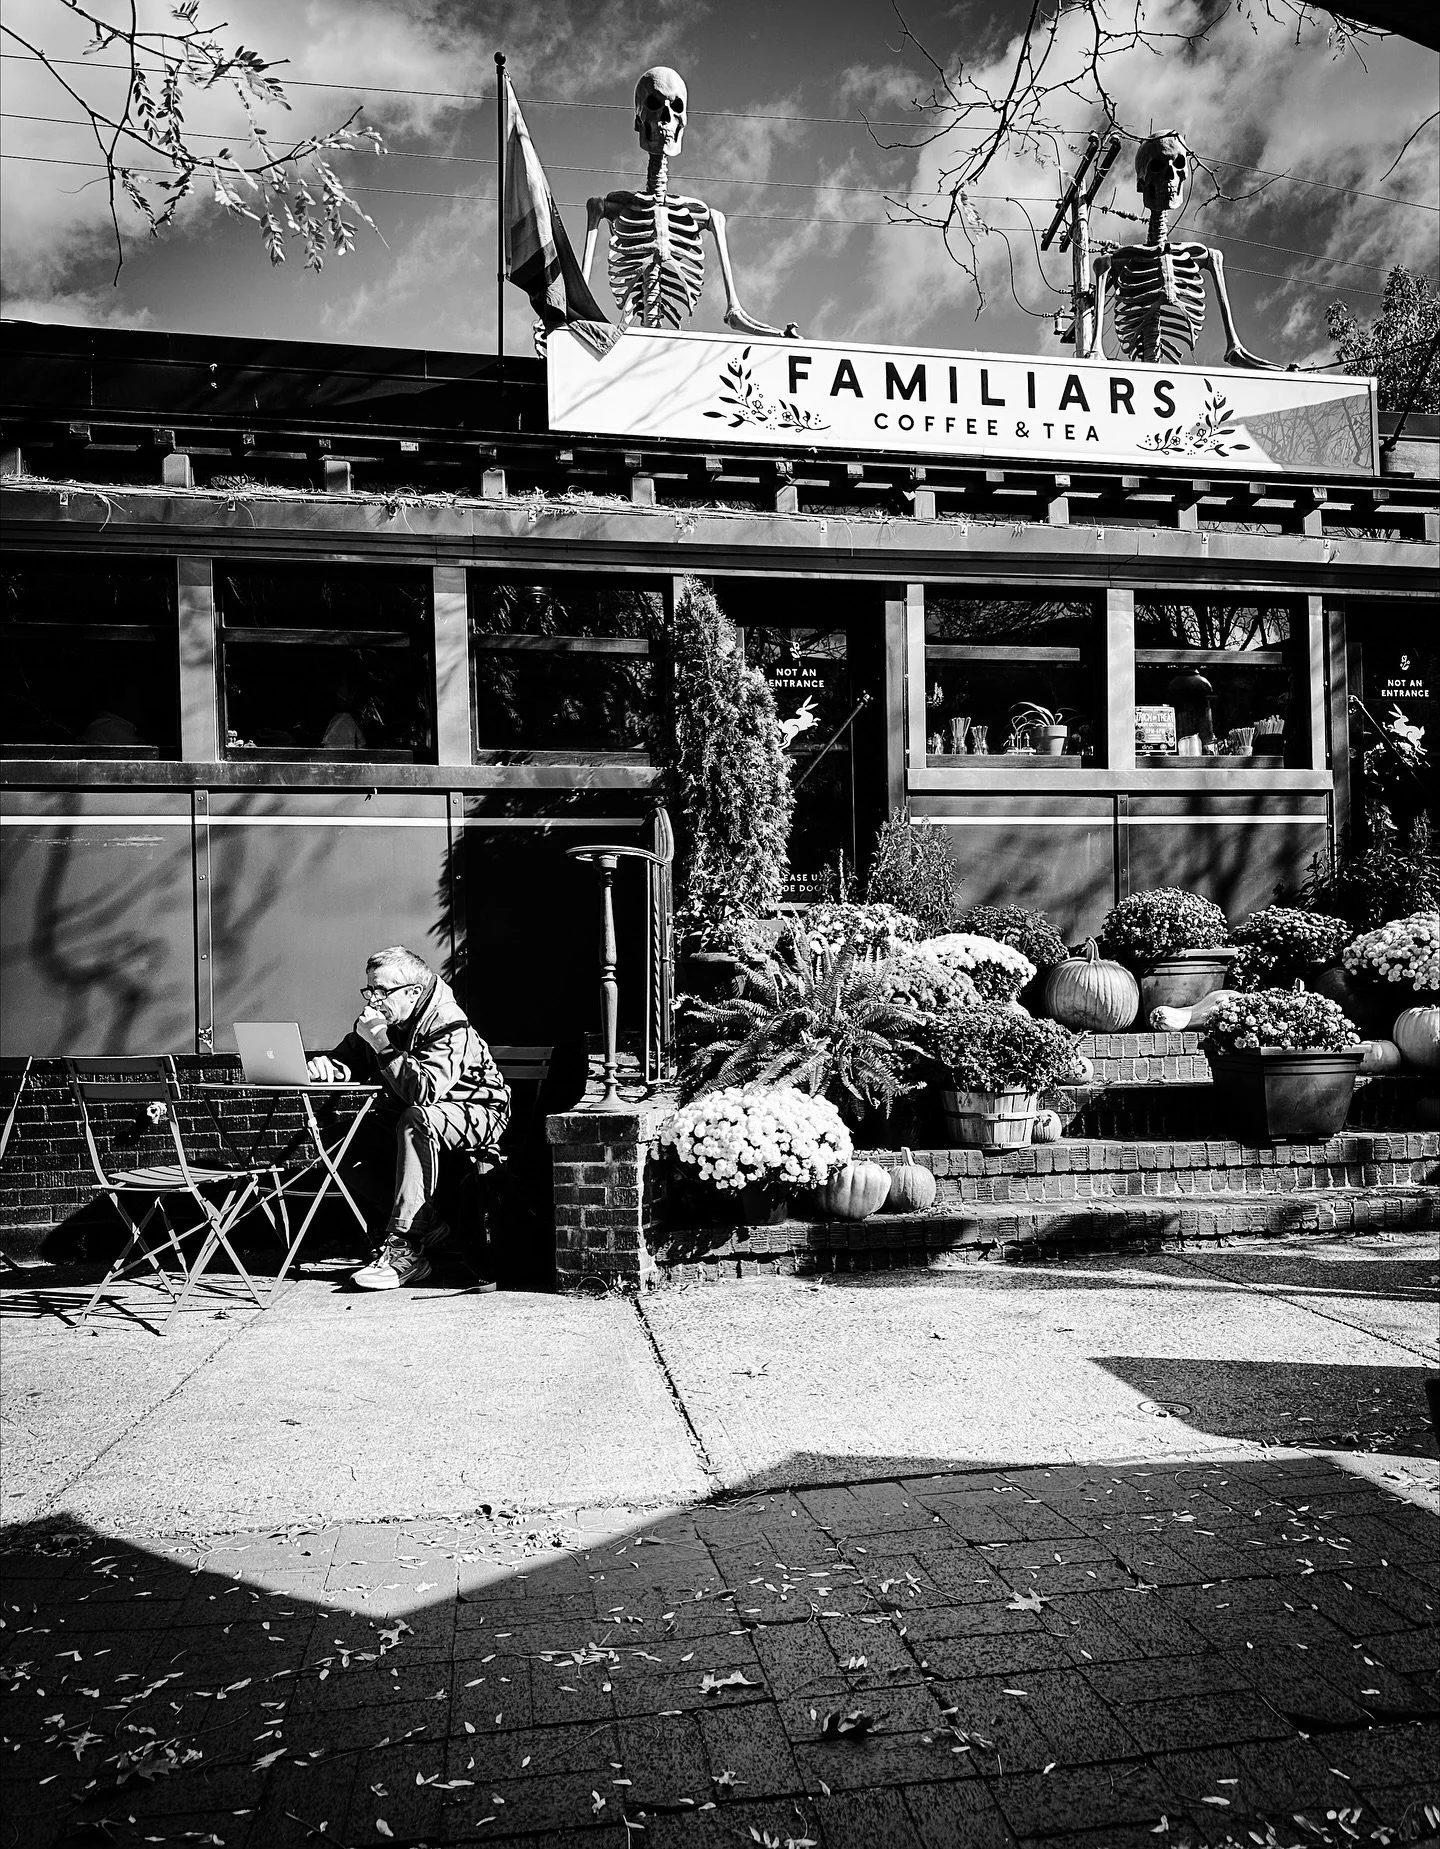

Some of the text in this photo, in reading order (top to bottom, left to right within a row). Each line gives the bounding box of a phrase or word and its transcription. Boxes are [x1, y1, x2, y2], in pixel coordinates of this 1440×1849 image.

[788, 355, 1176, 419] FAMILIARS
[874, 412, 1099, 442] COFFEE & TEA
[776, 668, 817, 677] NOT AN
[768, 679, 825, 688] ENTRANCE
[1387, 679, 1423, 687] NOT AN
[1381, 689, 1430, 698] ENTRANCE
[784, 873, 808, 882] EASE
